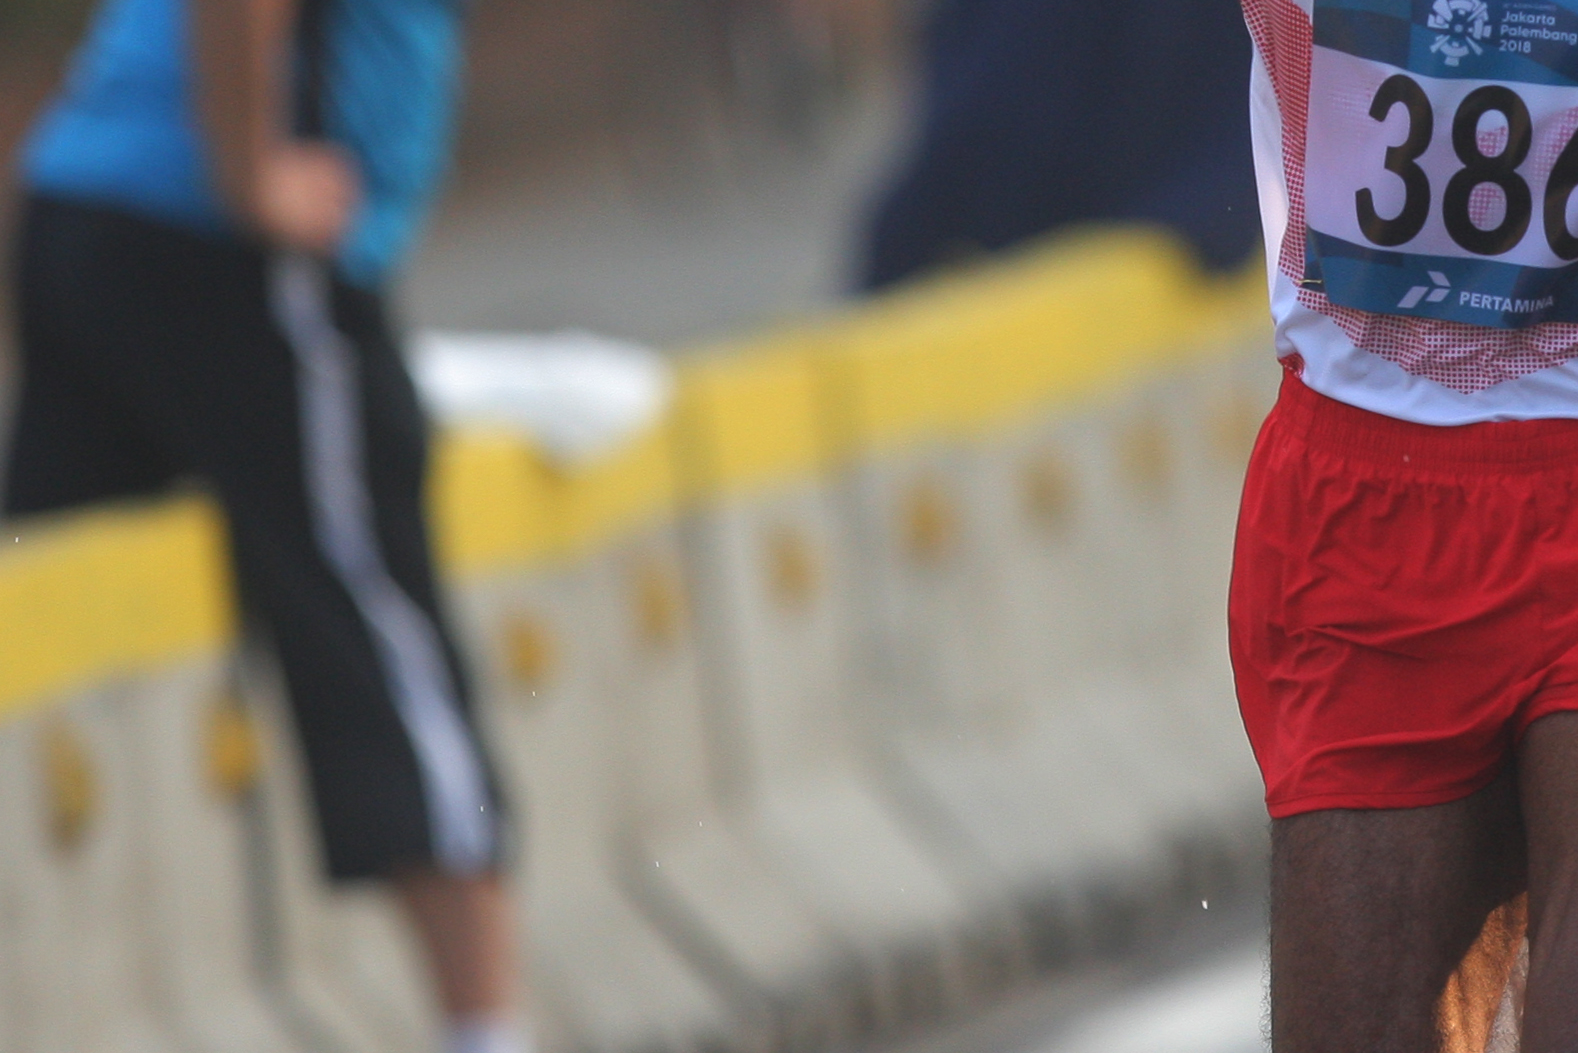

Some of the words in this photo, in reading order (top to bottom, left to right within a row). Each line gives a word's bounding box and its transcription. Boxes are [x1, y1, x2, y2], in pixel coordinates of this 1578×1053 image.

[1501, 11, 1556, 26] Jakarta
[1500, 24, 1578, 46] Palembang
[1499, 39, 1532, 54] 2018
[1459, 291, 1554, 313] PERTAMINA
